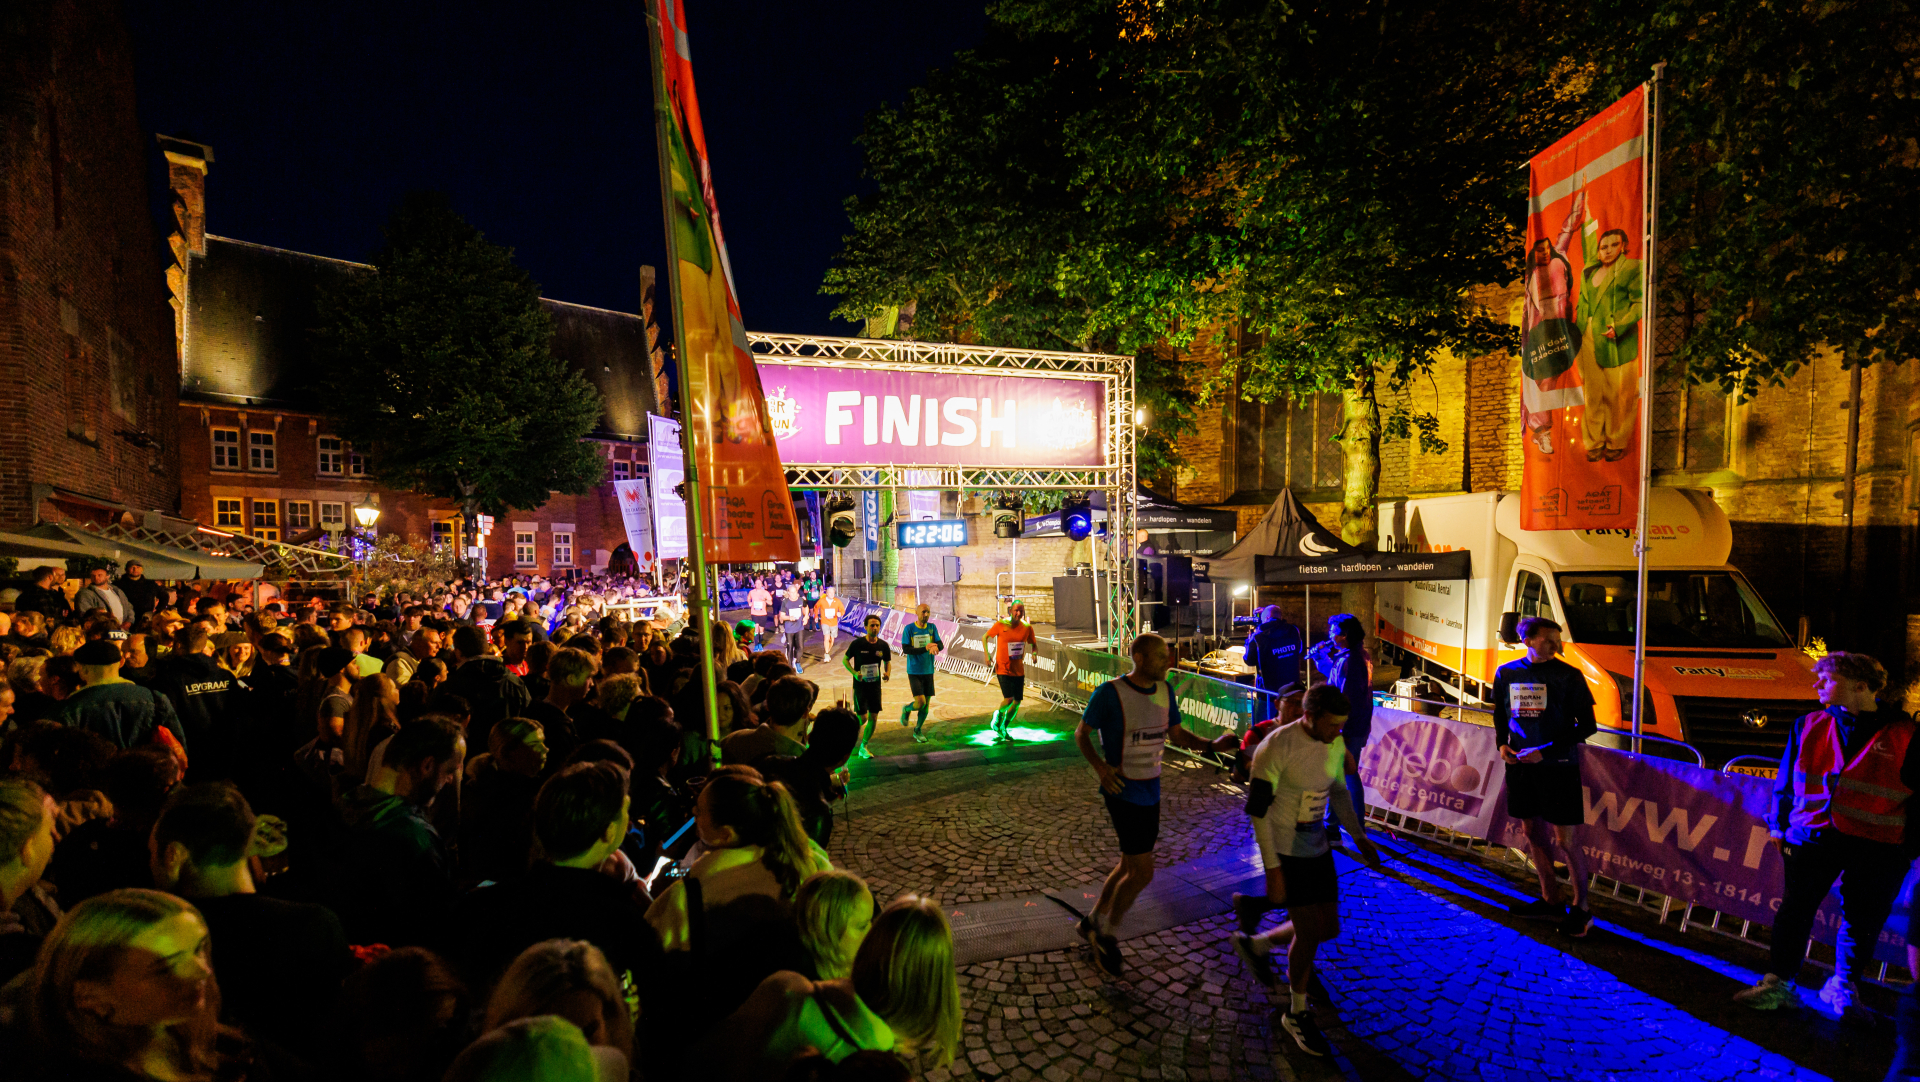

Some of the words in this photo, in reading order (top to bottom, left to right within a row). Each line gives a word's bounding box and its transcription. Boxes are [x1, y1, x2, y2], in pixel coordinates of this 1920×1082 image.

[825, 391, 1016, 448] FINISH
[905, 525, 964, 544] 1:22:06
[1299, 564, 1328, 574] fietsen
[1341, 562, 1382, 573] hardlopen
[1396, 561, 1434, 572] wandelen
[1272, 644, 1296, 655] PHOTO
[185, 680, 230, 693] LEYGRAAF
[1672, 869, 1694, 886] 13
[1713, 881, 1763, 907] 1814
